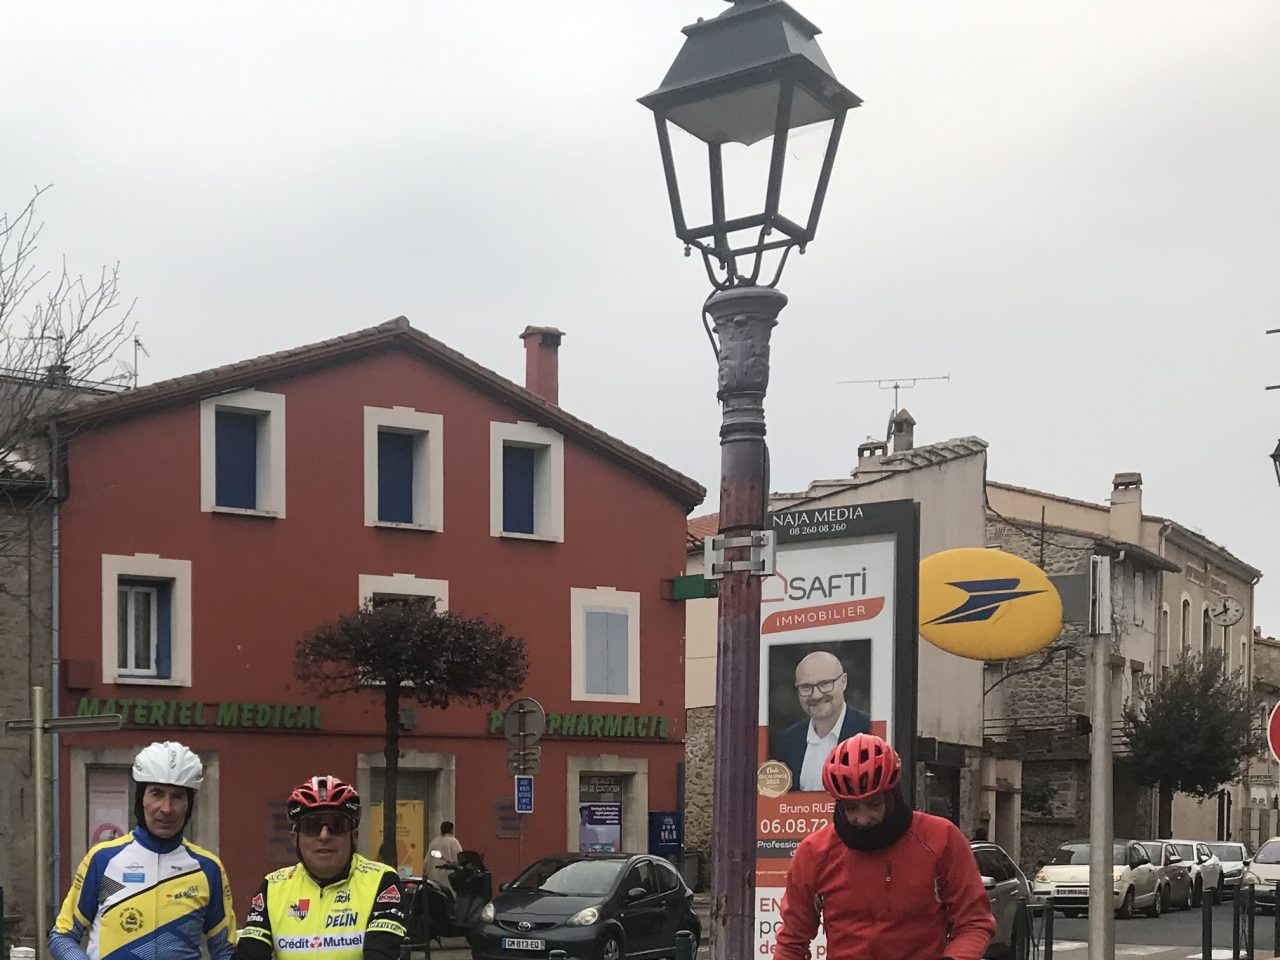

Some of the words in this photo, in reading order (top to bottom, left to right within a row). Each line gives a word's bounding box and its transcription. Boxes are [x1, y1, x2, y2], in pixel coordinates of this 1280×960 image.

[773, 512, 810, 527] NAJA
[814, 506, 864, 523] MEDIA
[789, 526, 800, 535] 08
[801, 525, 817, 534] 260
[818, 524, 829, 533] 08
[831, 522, 847, 532] 260
[776, 605, 866, 627] IMMOBILIER
[77, 698, 207, 728] MATERIEL
[215, 701, 325, 729] MEDICAL
[545, 712, 669, 738] PHARMACIE
[779, 804, 810, 814] Bruno
[812, 802, 835, 813] RUE
[326, 911, 358, 929] DELIN
[278, 938, 310, 949] Crédit
[323, 934, 363, 948] Mutuel
